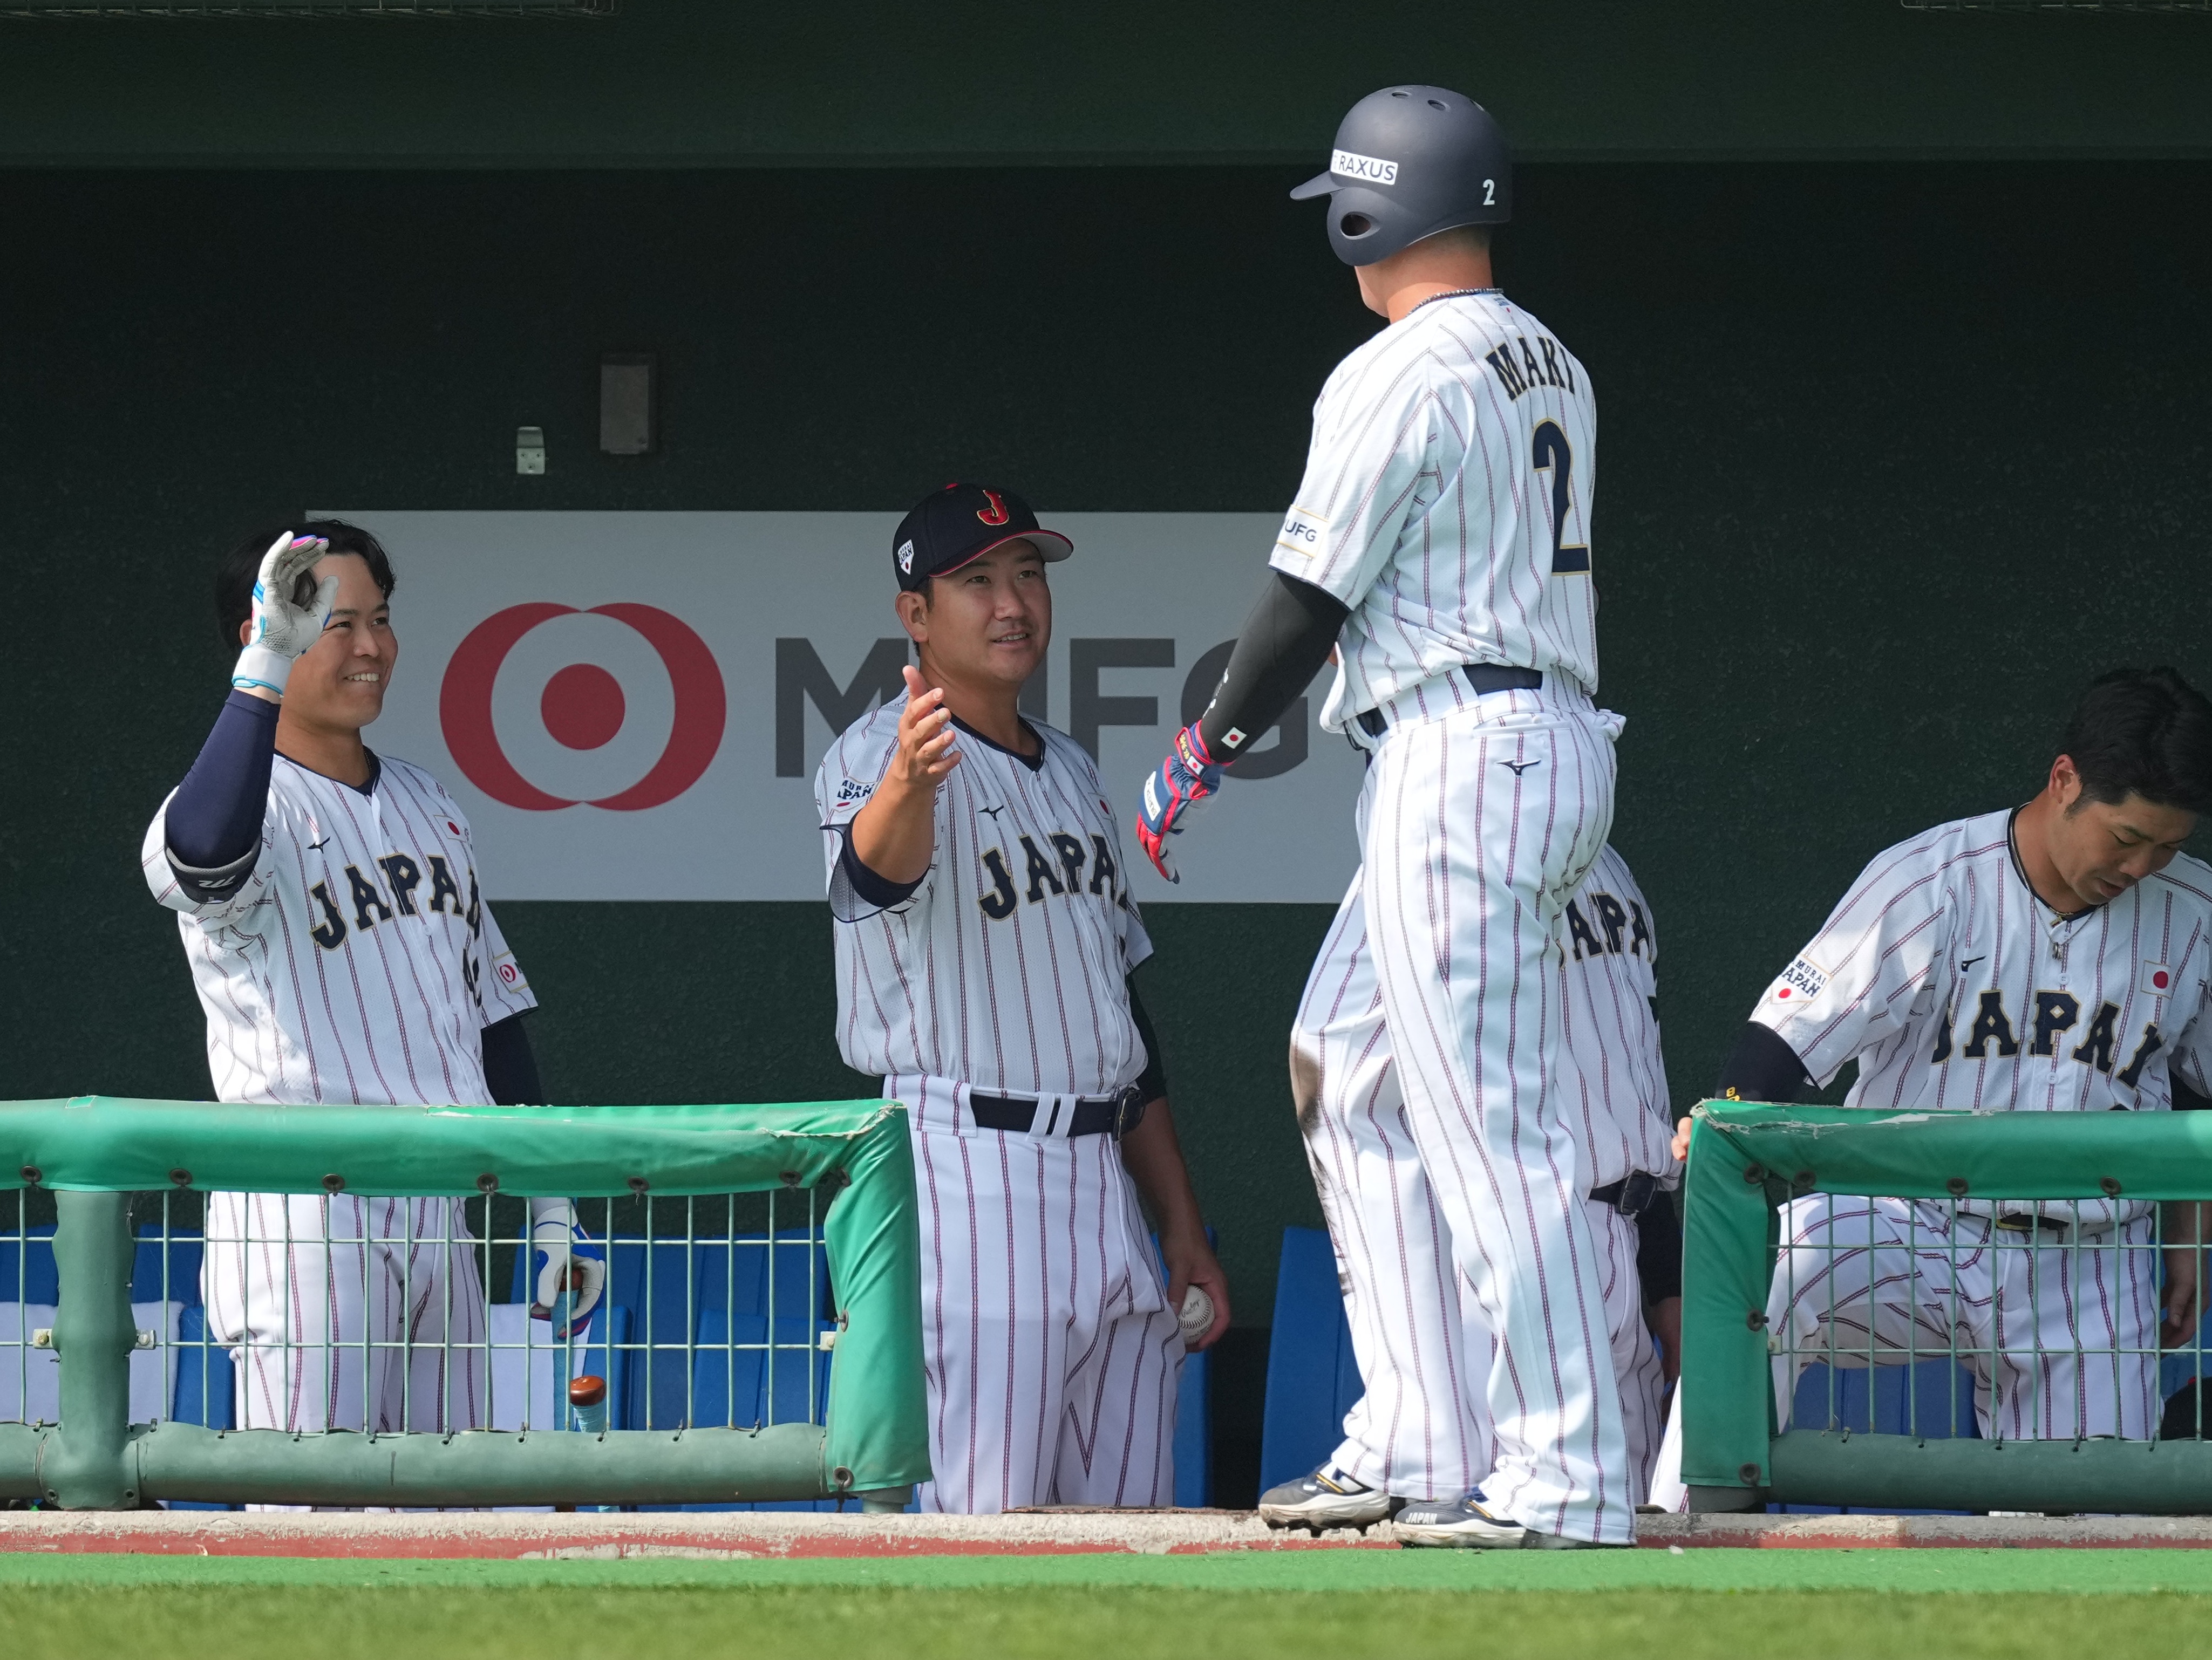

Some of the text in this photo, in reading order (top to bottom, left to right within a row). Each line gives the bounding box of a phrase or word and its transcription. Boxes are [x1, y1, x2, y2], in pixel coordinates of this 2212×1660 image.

[1482, 179, 1495, 205] 2
[1485, 335, 1575, 402] MAKI
[977, 489, 1010, 525] J
[1532, 418, 1591, 576] 2
[1284, 518, 1317, 542] UFG
[775, 638, 1309, 780] MFG
[1781, 967, 1821, 997] APAN
[1793, 960, 1827, 985] MURAI
[1405, 1512, 1438, 1525] JAPAN
